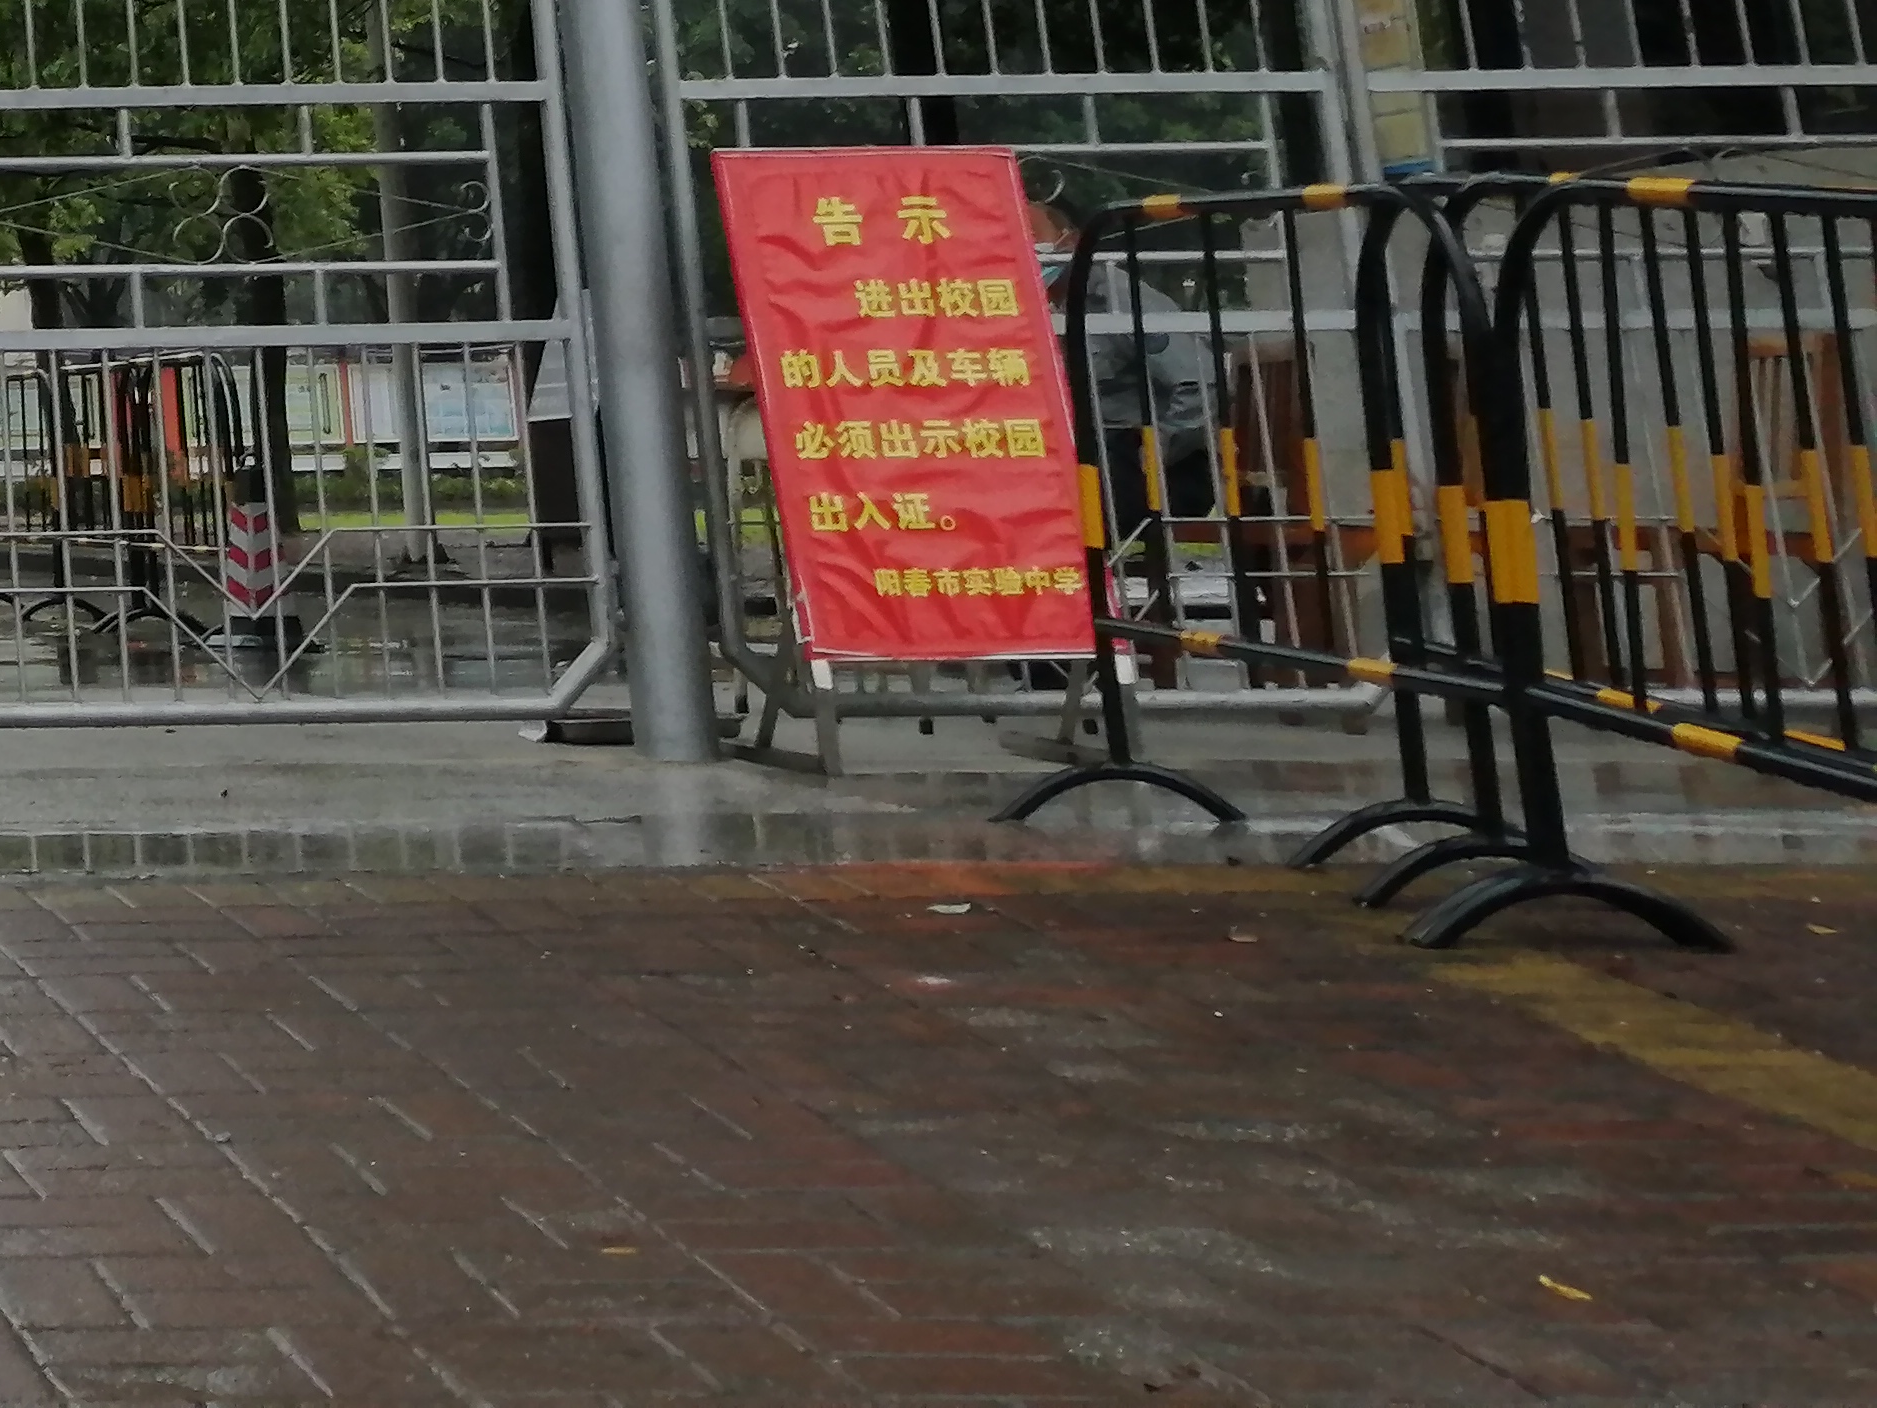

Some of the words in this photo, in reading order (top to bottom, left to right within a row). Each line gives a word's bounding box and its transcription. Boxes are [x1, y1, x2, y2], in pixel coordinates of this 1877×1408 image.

[853, 277, 1020, 318] 进出校园
[780, 348, 1032, 388] 的人员及车辆
[795, 418, 1046, 459] 必须出示校园
[808, 491, 956, 532] 出入证。
[874, 566, 1084, 597] 阳春市实验中学
